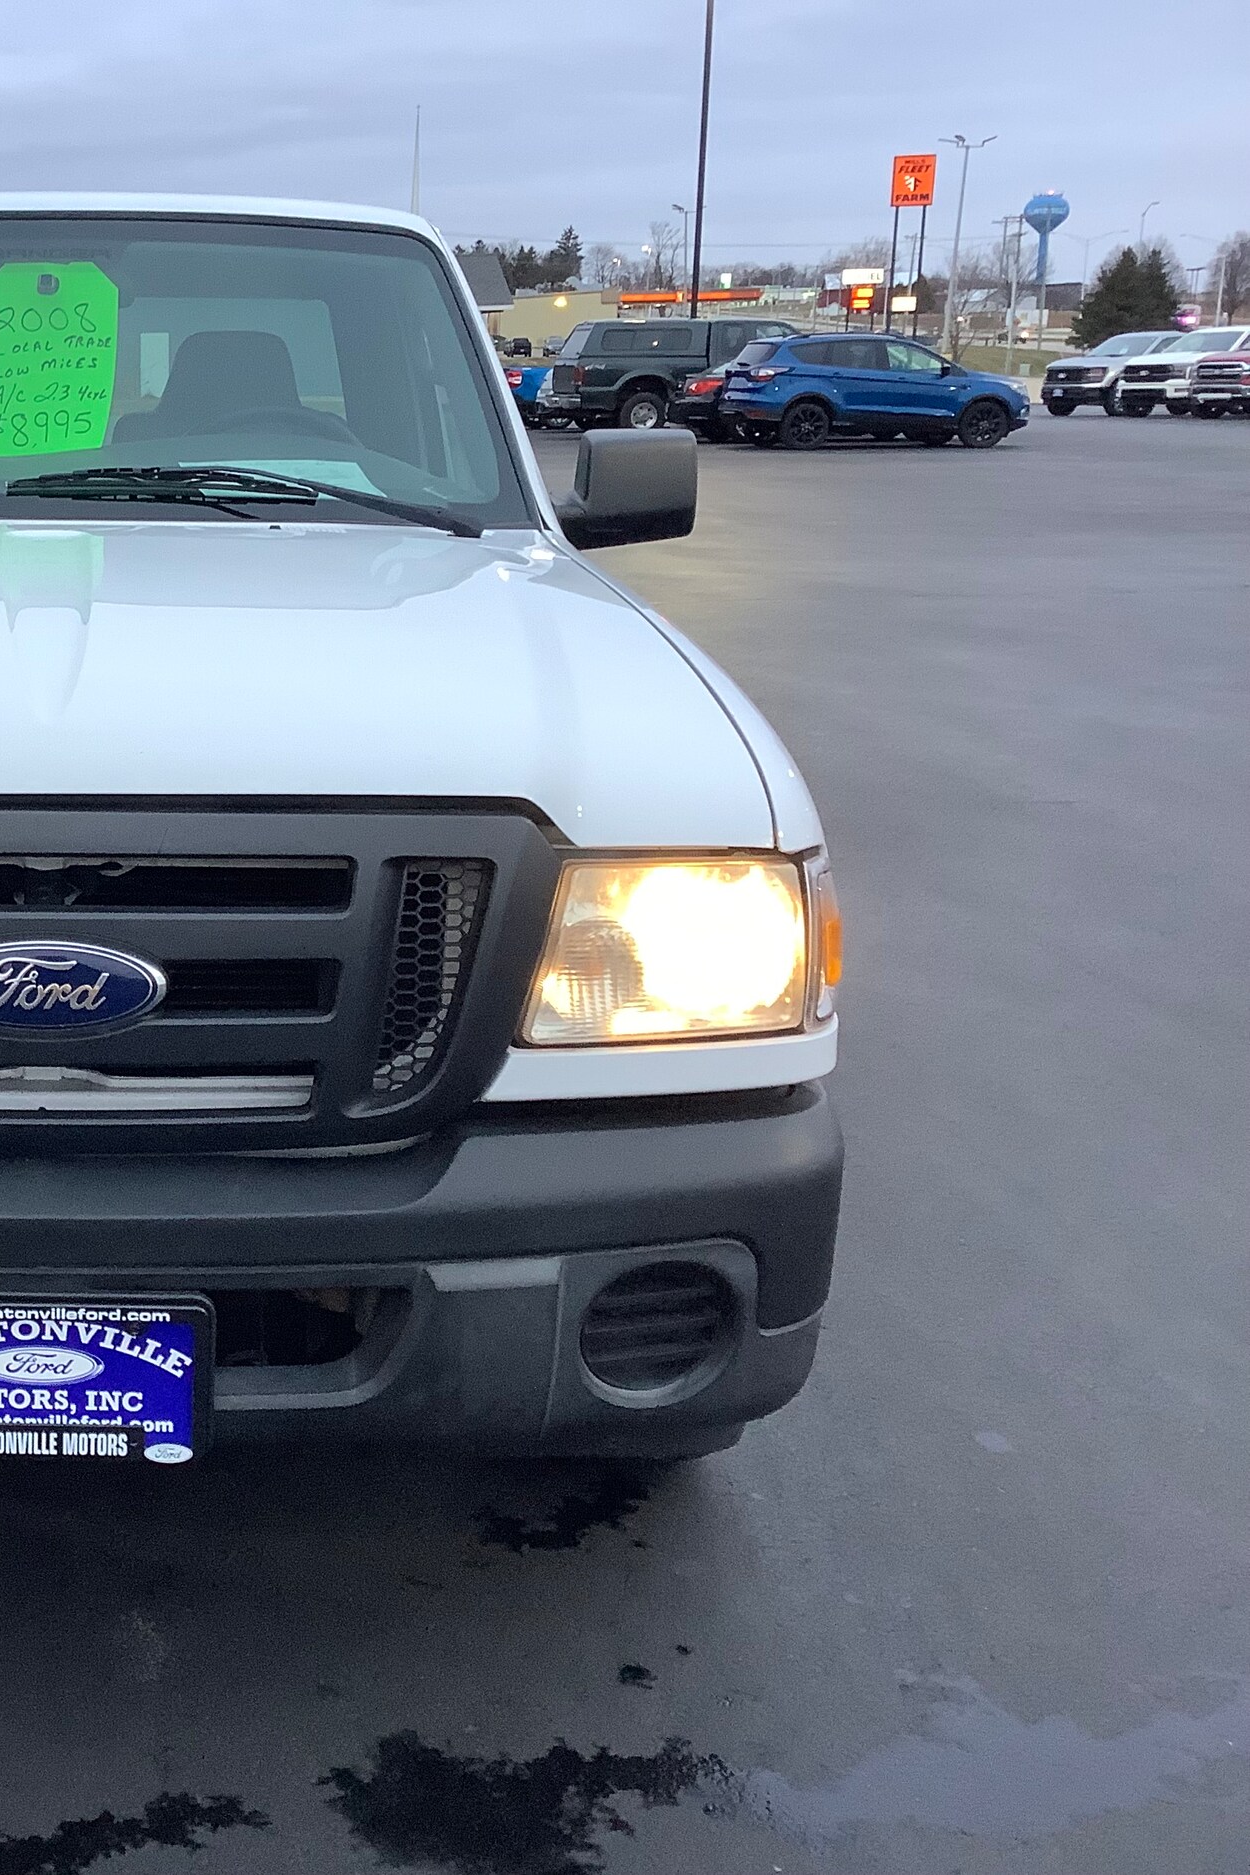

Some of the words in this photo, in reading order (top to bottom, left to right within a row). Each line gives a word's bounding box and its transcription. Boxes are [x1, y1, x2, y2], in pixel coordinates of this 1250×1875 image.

[898, 165, 931, 173] FLEET
[895, 193, 929, 202] FARM
[33, 381, 70, 403] 2.3
[5, 1352, 74, 1377] Ford
[85, 1391, 143, 1412] INC
[62, 1432, 128, 1457] MOTORS
